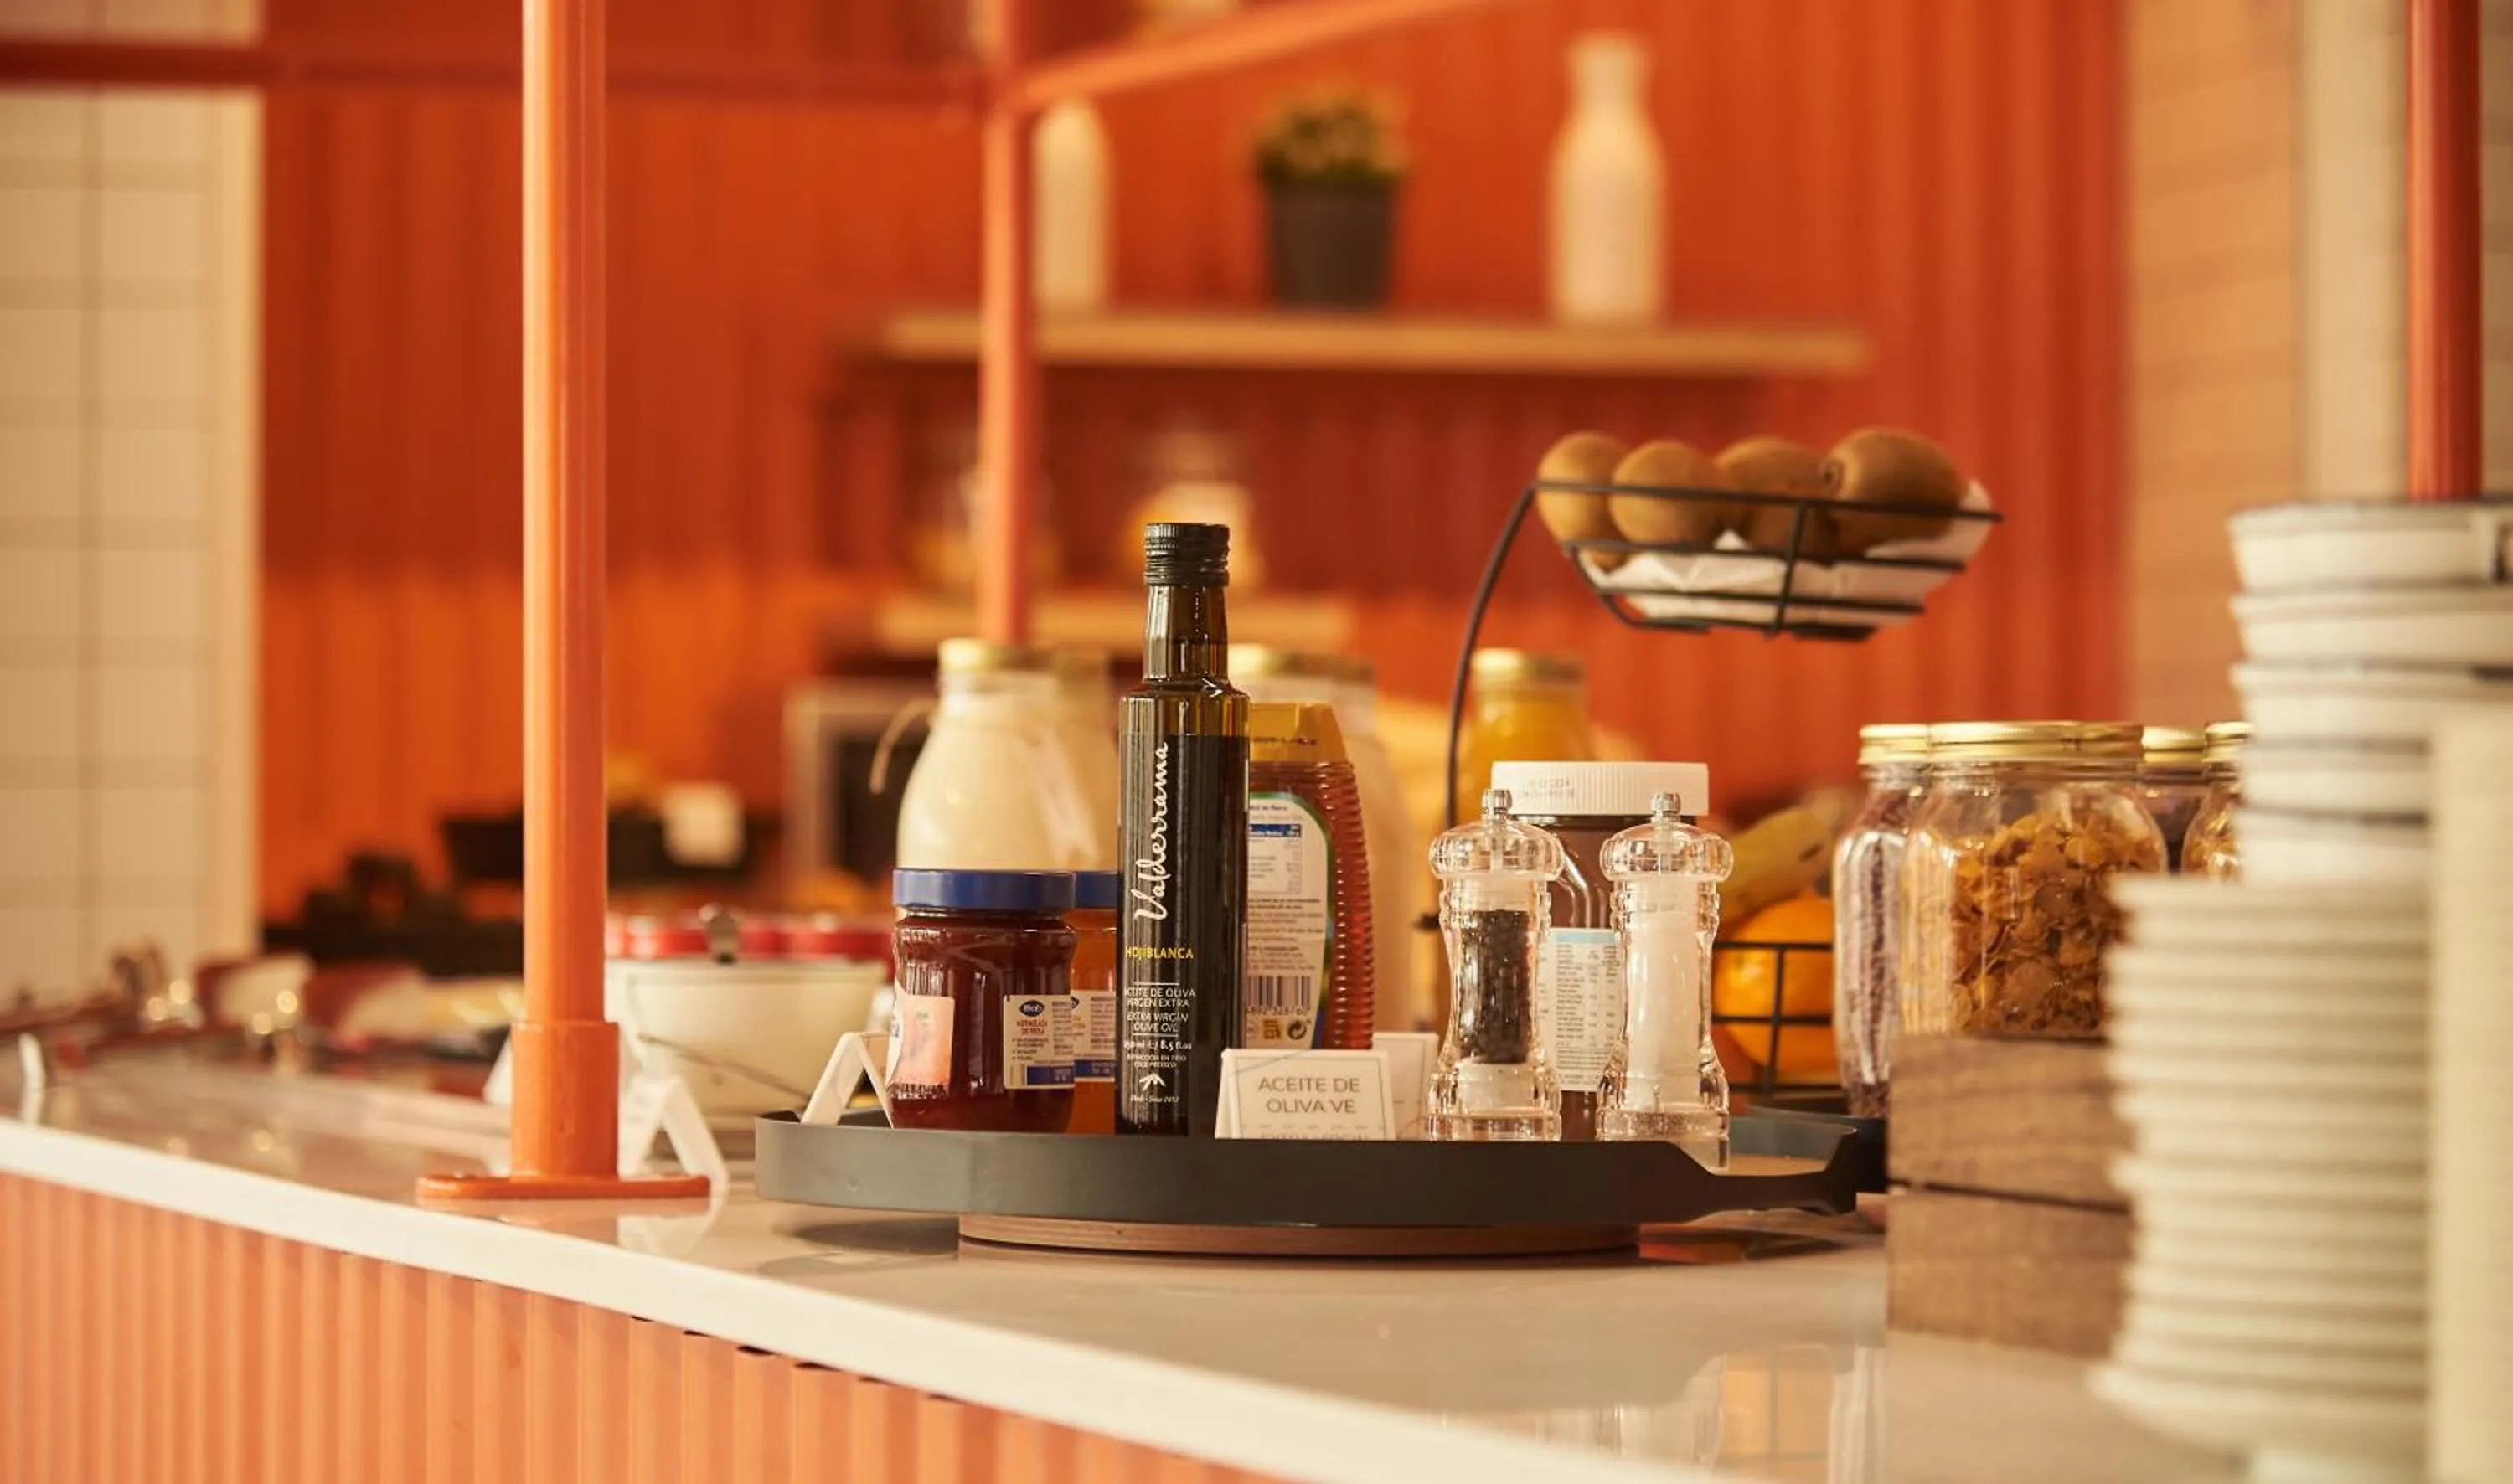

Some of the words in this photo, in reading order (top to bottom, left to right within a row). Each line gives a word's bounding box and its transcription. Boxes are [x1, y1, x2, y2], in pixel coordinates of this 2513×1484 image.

[1131, 742, 1171, 920] Valderrama
[1125, 946, 1194, 961] HOJIBLANCA
[1151, 988, 1164, 997] DE
[1165, 988, 1196, 998] OLIVA
[1158, 998, 1190, 1008] EXTRA
[1258, 1077, 1326, 1092] ACEITE
[1334, 1078, 1361, 1093] DE
[1267, 1098, 1324, 1114] OLIVA
[1332, 1099, 1356, 1114] VE
